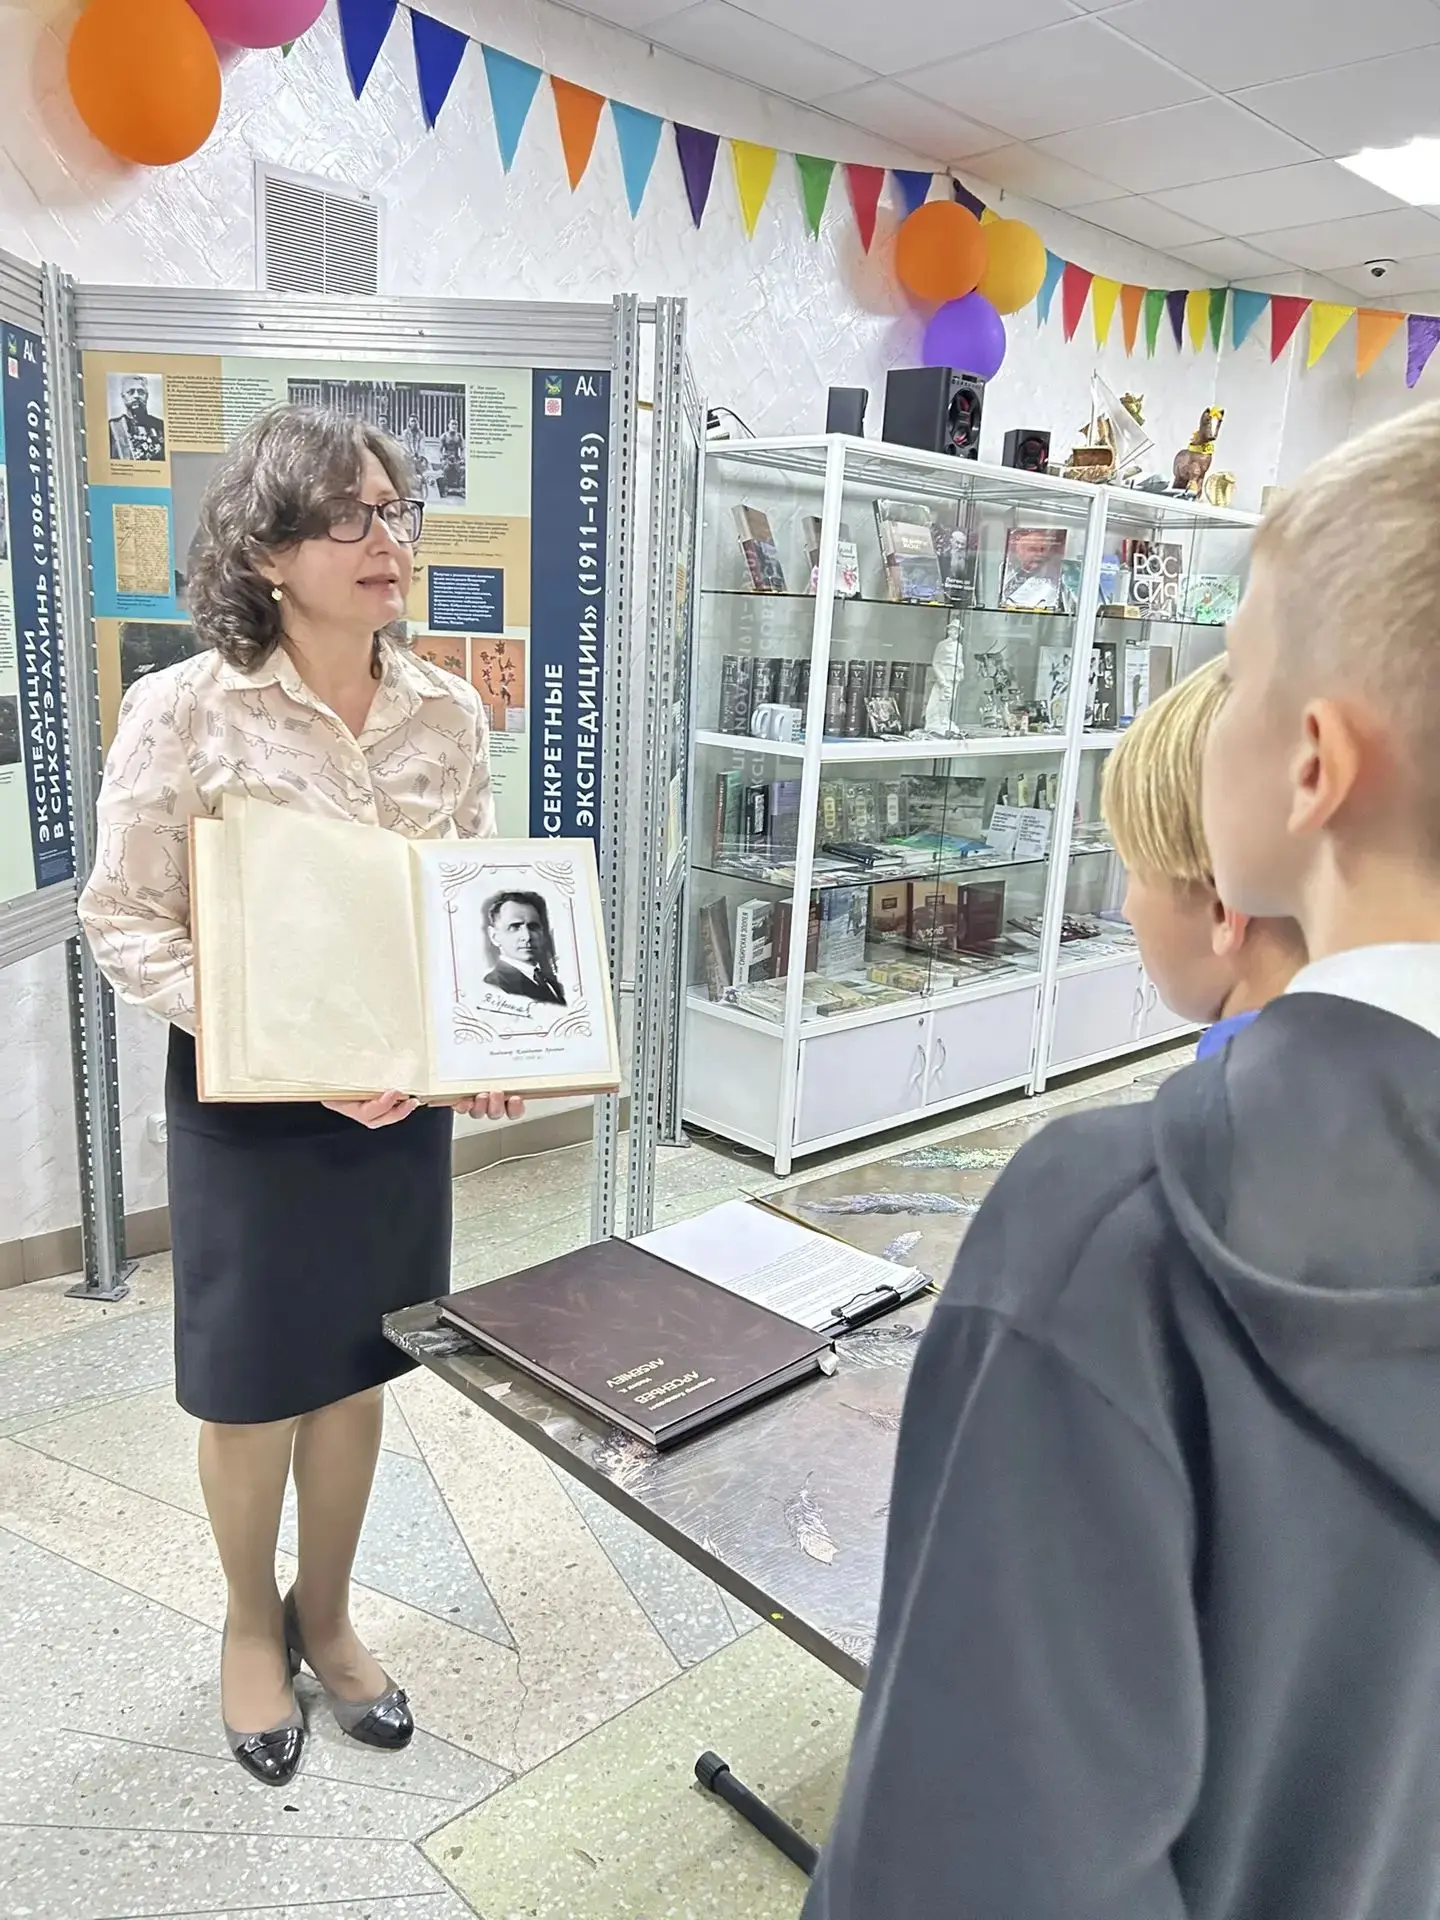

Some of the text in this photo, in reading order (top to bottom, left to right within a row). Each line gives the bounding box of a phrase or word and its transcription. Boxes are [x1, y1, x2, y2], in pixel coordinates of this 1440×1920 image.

[1133, 552, 1178, 577] РОС
[36, 573, 62, 813] СИХОТЭ-АЛИНЬ
[576, 605, 600, 827] ЭКСПЕДИЦИИ»
[24, 630, 50, 843] ЭКСПЕДИЦИИ
[53, 822, 64, 839] В
[606, 1357, 665, 1389] ARSENIEV
[633, 1370, 699, 1404] АРСЕНЬЕВ
